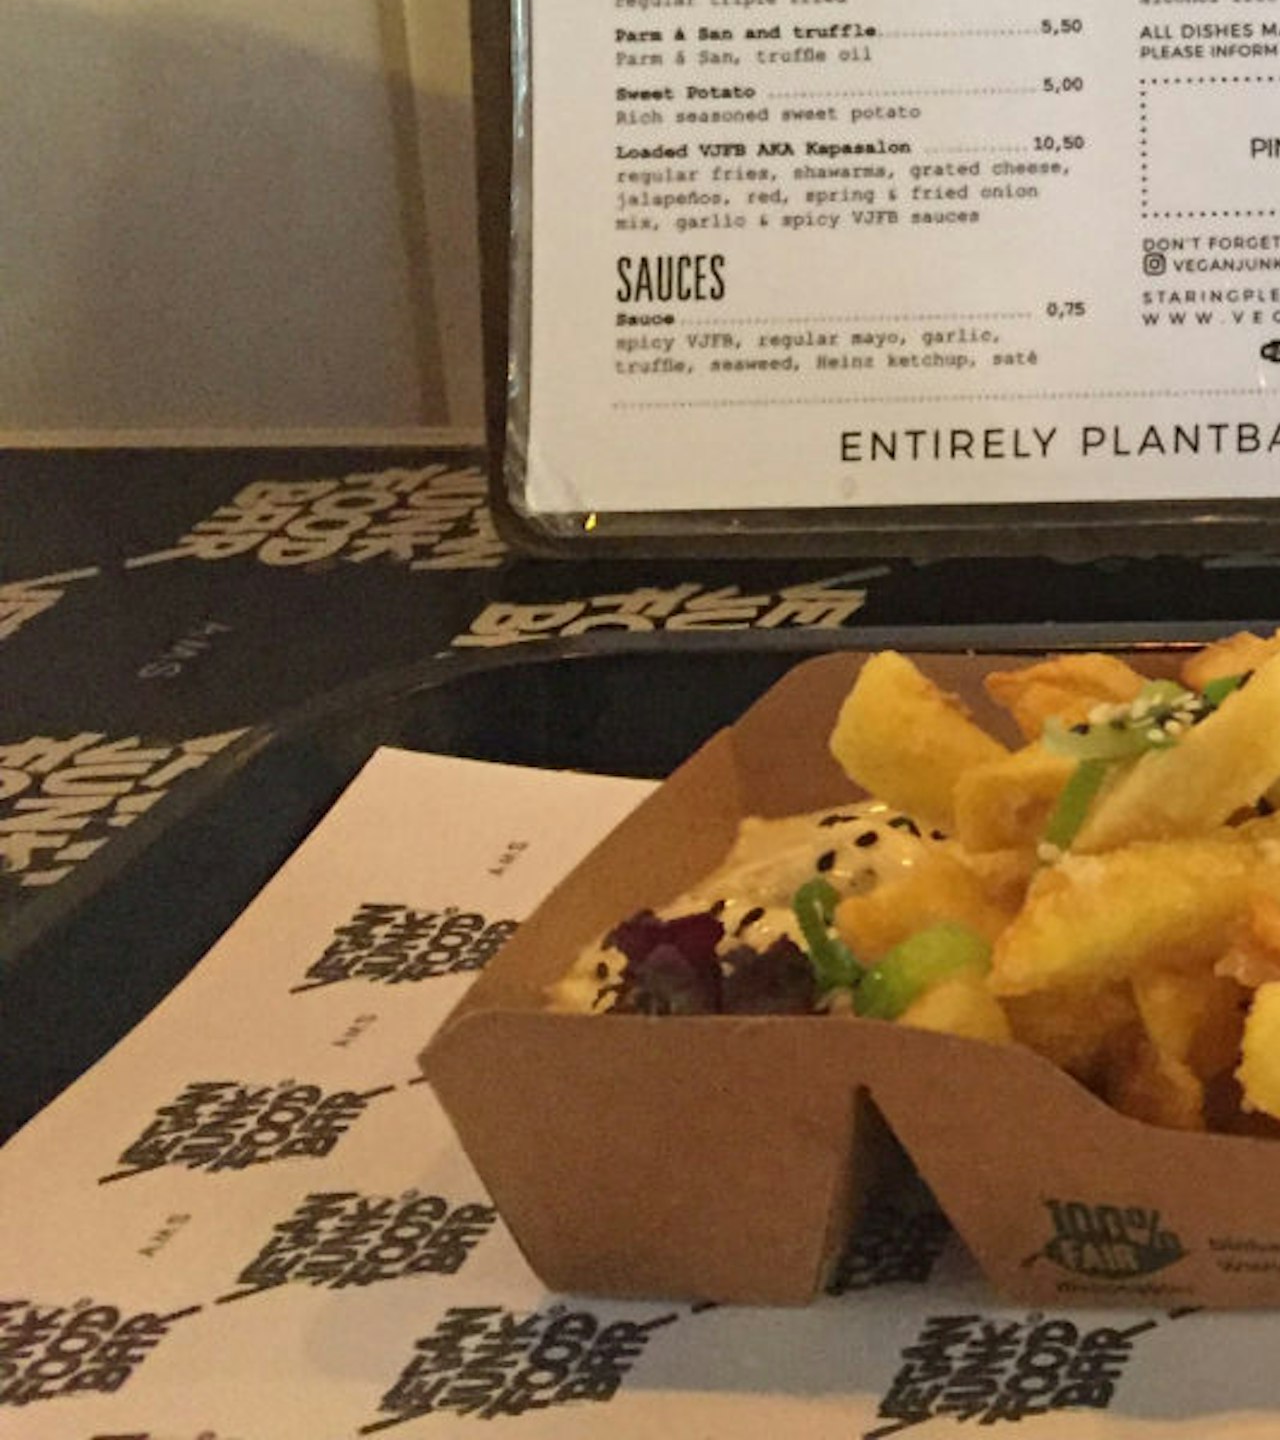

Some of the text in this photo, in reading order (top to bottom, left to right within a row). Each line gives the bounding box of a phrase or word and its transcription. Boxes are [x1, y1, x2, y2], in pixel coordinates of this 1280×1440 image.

[1139, 25, 1173, 41] ALL
[1180, 23, 1254, 39] DISHES
[616, 76, 1083, 101] Sweet Potato 5,00
[616, 135, 1085, 159] Loaded VJFB AKA Kapasalon 10,50
[616, 254, 725, 302] SAUCES
[616, 301, 1086, 326] Sauce 0,75
[841, 428, 1056, 461] ENTIRELY
